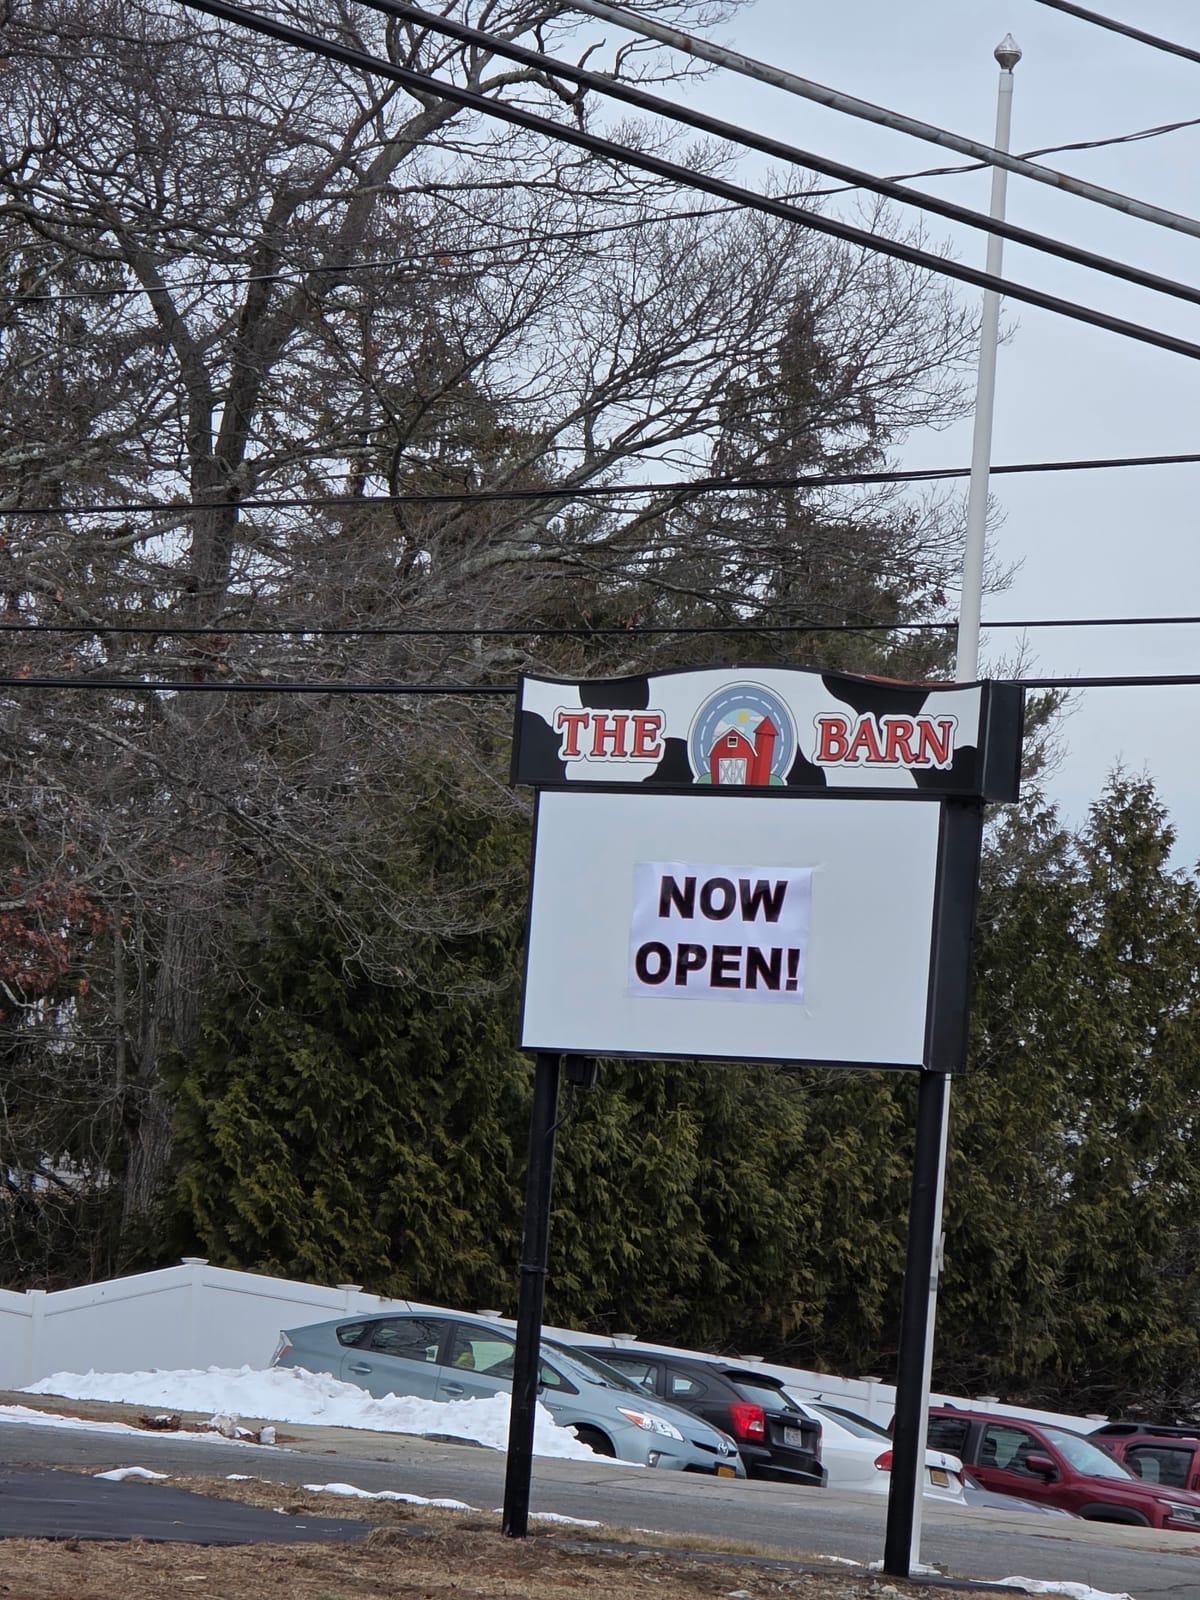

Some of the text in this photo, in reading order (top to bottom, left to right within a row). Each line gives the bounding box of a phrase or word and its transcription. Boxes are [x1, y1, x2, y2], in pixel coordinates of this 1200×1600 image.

[556, 712, 954, 765] THE BARN
[658, 875, 788, 923] NOW
[634, 941, 801, 991] OPEN!
